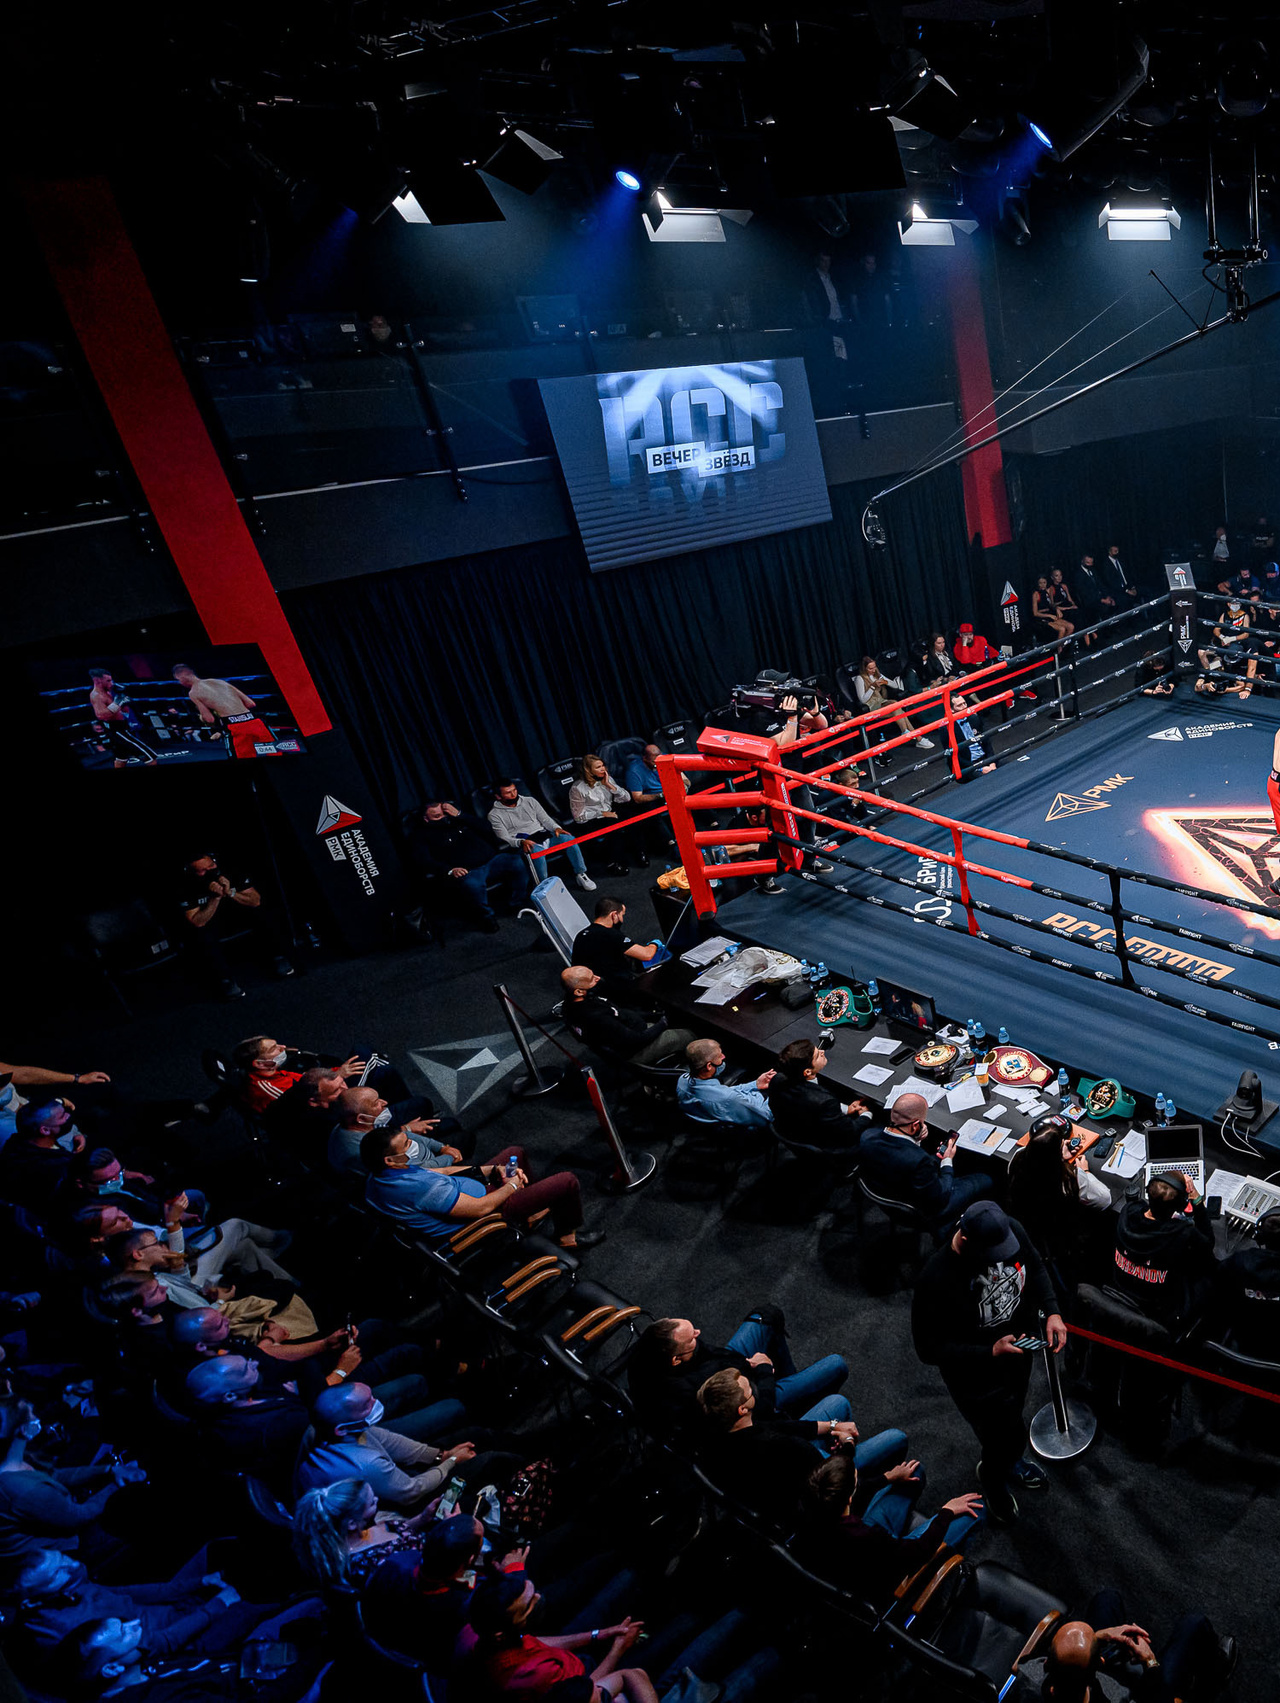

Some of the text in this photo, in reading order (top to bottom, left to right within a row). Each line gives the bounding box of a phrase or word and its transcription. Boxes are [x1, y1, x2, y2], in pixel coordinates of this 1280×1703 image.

[652, 447, 700, 467] ВЕЧЕР
[705, 448, 751, 471] ЗВЁЗД
[327, 838, 344, 859] РМК
[351, 829, 380, 878] АКАДЕМИЯ
[340, 832, 376, 896] ЕДИНОБОРСТВ
[1052, 926, 1072, 938] FAIRFIGHT
[1179, 928, 1202, 941] FAIRFIGHT
[1129, 938, 1225, 981] BOXING
[1231, 1022, 1255, 1033] FAIRFIGHT
